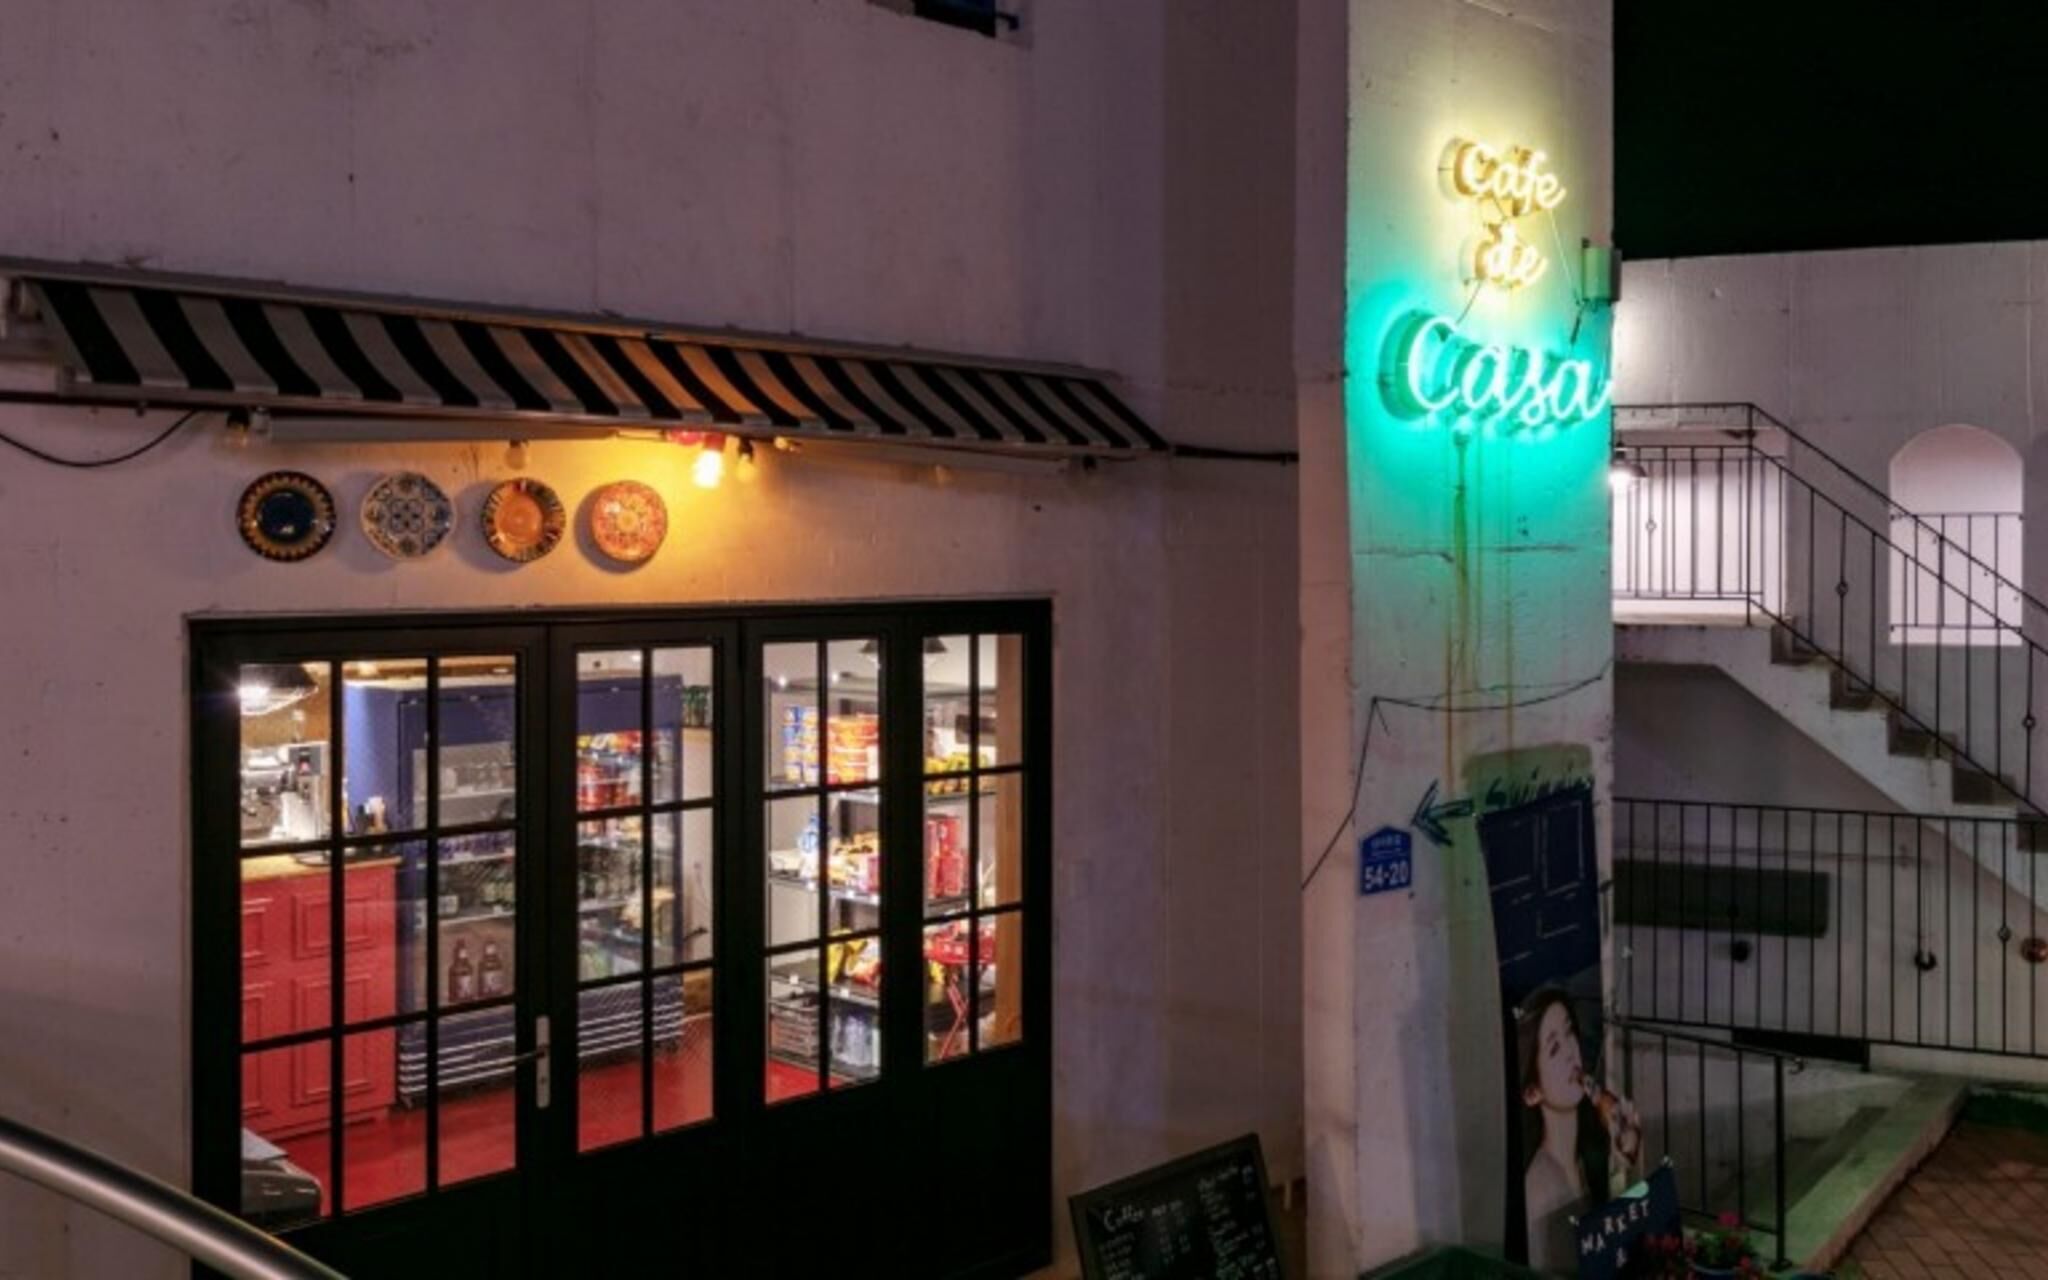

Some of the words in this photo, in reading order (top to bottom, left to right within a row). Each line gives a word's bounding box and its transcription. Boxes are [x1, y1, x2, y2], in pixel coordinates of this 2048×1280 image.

[1456, 142, 1567, 214] Cafe
[1476, 223, 1547, 289] de
[1404, 315, 1613, 425] Casa
[1364, 860, 1409, 890] 54-20
[1581, 1199, 1650, 1255] MARKET
